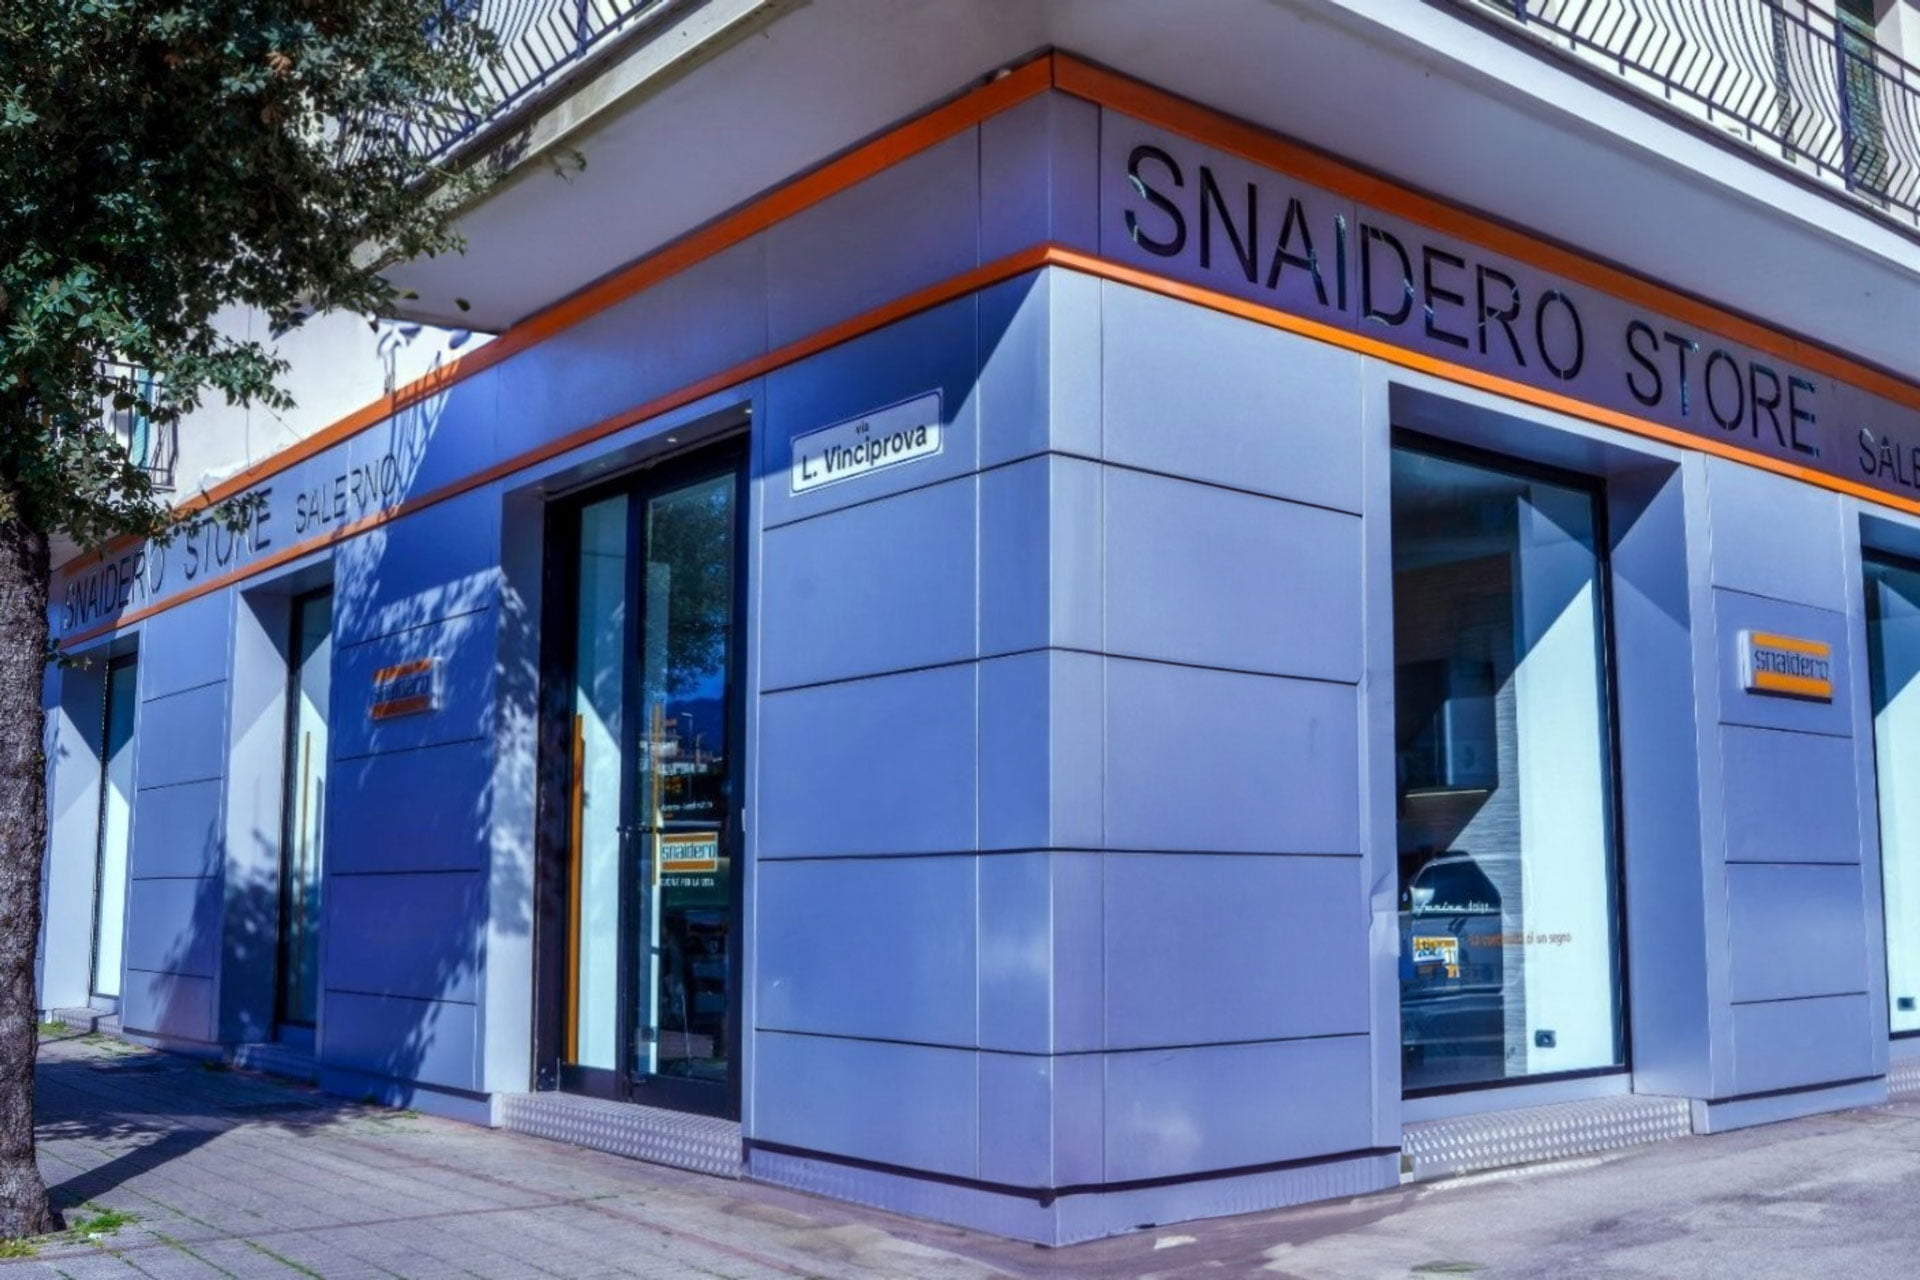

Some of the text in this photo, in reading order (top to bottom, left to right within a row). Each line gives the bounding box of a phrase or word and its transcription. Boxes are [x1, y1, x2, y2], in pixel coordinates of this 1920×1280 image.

[1124, 145, 1585, 381] SNAIDERO
[1625, 319, 1819, 458] STORE
[802, 425, 927, 481] L. Vinciprova
[855, 421, 870, 435] via
[63, 543, 165, 631] SNAIDERO
[296, 453, 397, 534] SALERNO
[1755, 649, 1829, 680] snaidero
